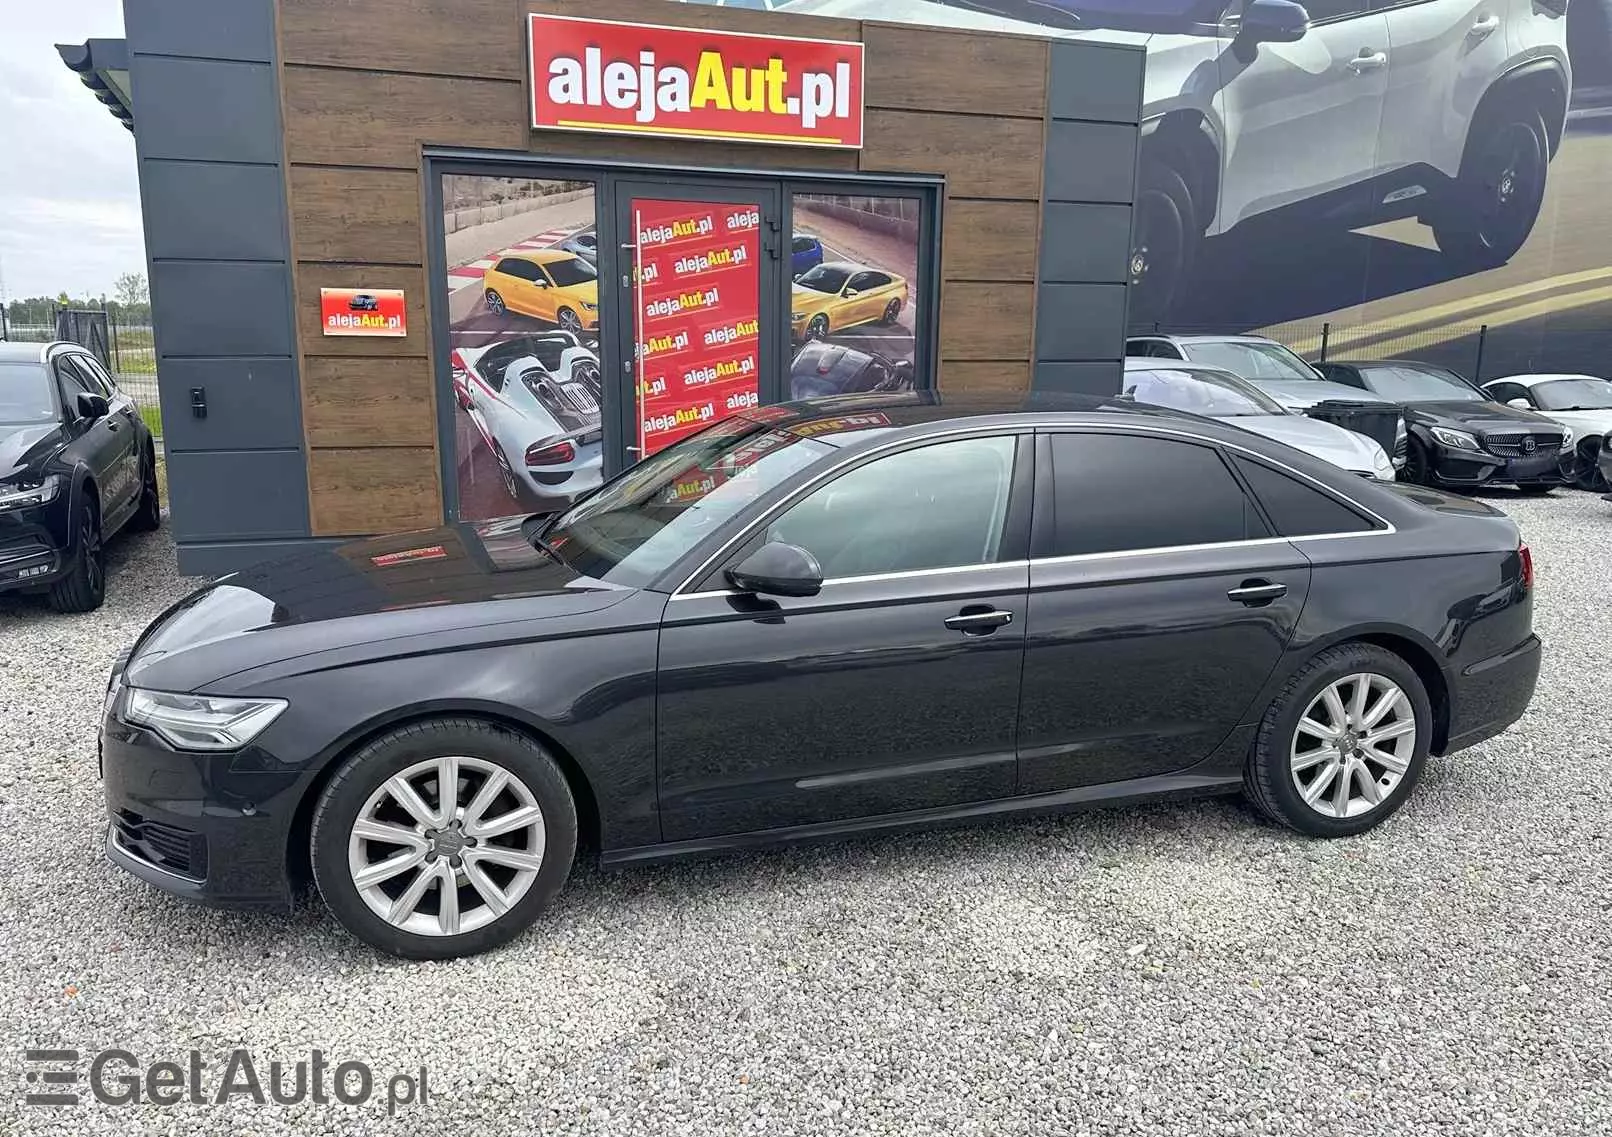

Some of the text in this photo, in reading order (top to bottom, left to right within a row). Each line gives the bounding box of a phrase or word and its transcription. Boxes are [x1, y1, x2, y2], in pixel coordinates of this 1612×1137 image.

[549, 47, 849, 128] alejaAut.pl
[640, 216, 713, 244] alejaAut.pl
[674, 245, 747, 274] alejaAut.pl
[646, 288, 719, 317] alejaAut.pl
[328, 313, 400, 330] alejaAut.pl
[684, 356, 755, 385] alejaAut.pl
[644, 403, 714, 432] alejaAut.pl
